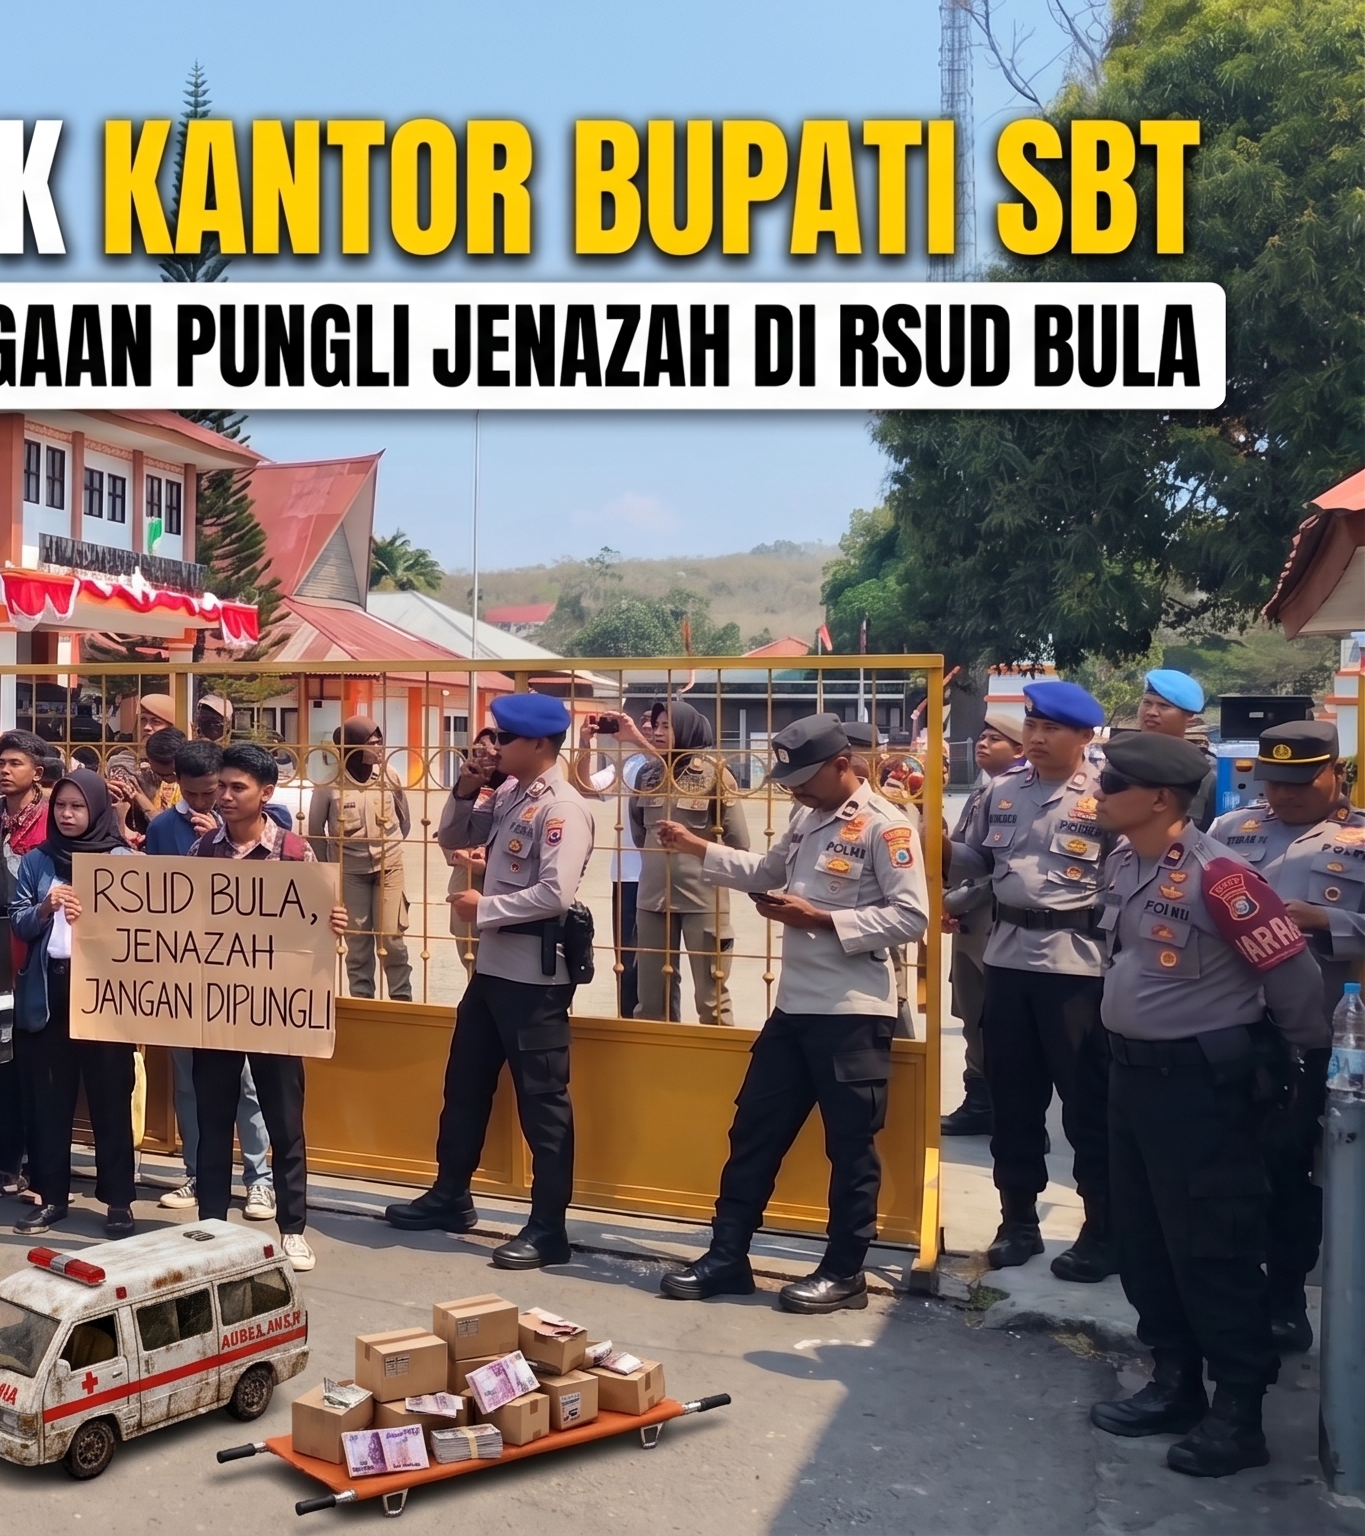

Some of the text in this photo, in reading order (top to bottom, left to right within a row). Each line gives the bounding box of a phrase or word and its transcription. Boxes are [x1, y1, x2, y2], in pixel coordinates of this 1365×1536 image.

[93, 867, 319, 926] RSUD BULA,
[111, 927, 275, 971] JENAZAH
[80, 977, 332, 1032] JANGAN DIPUNGLI
